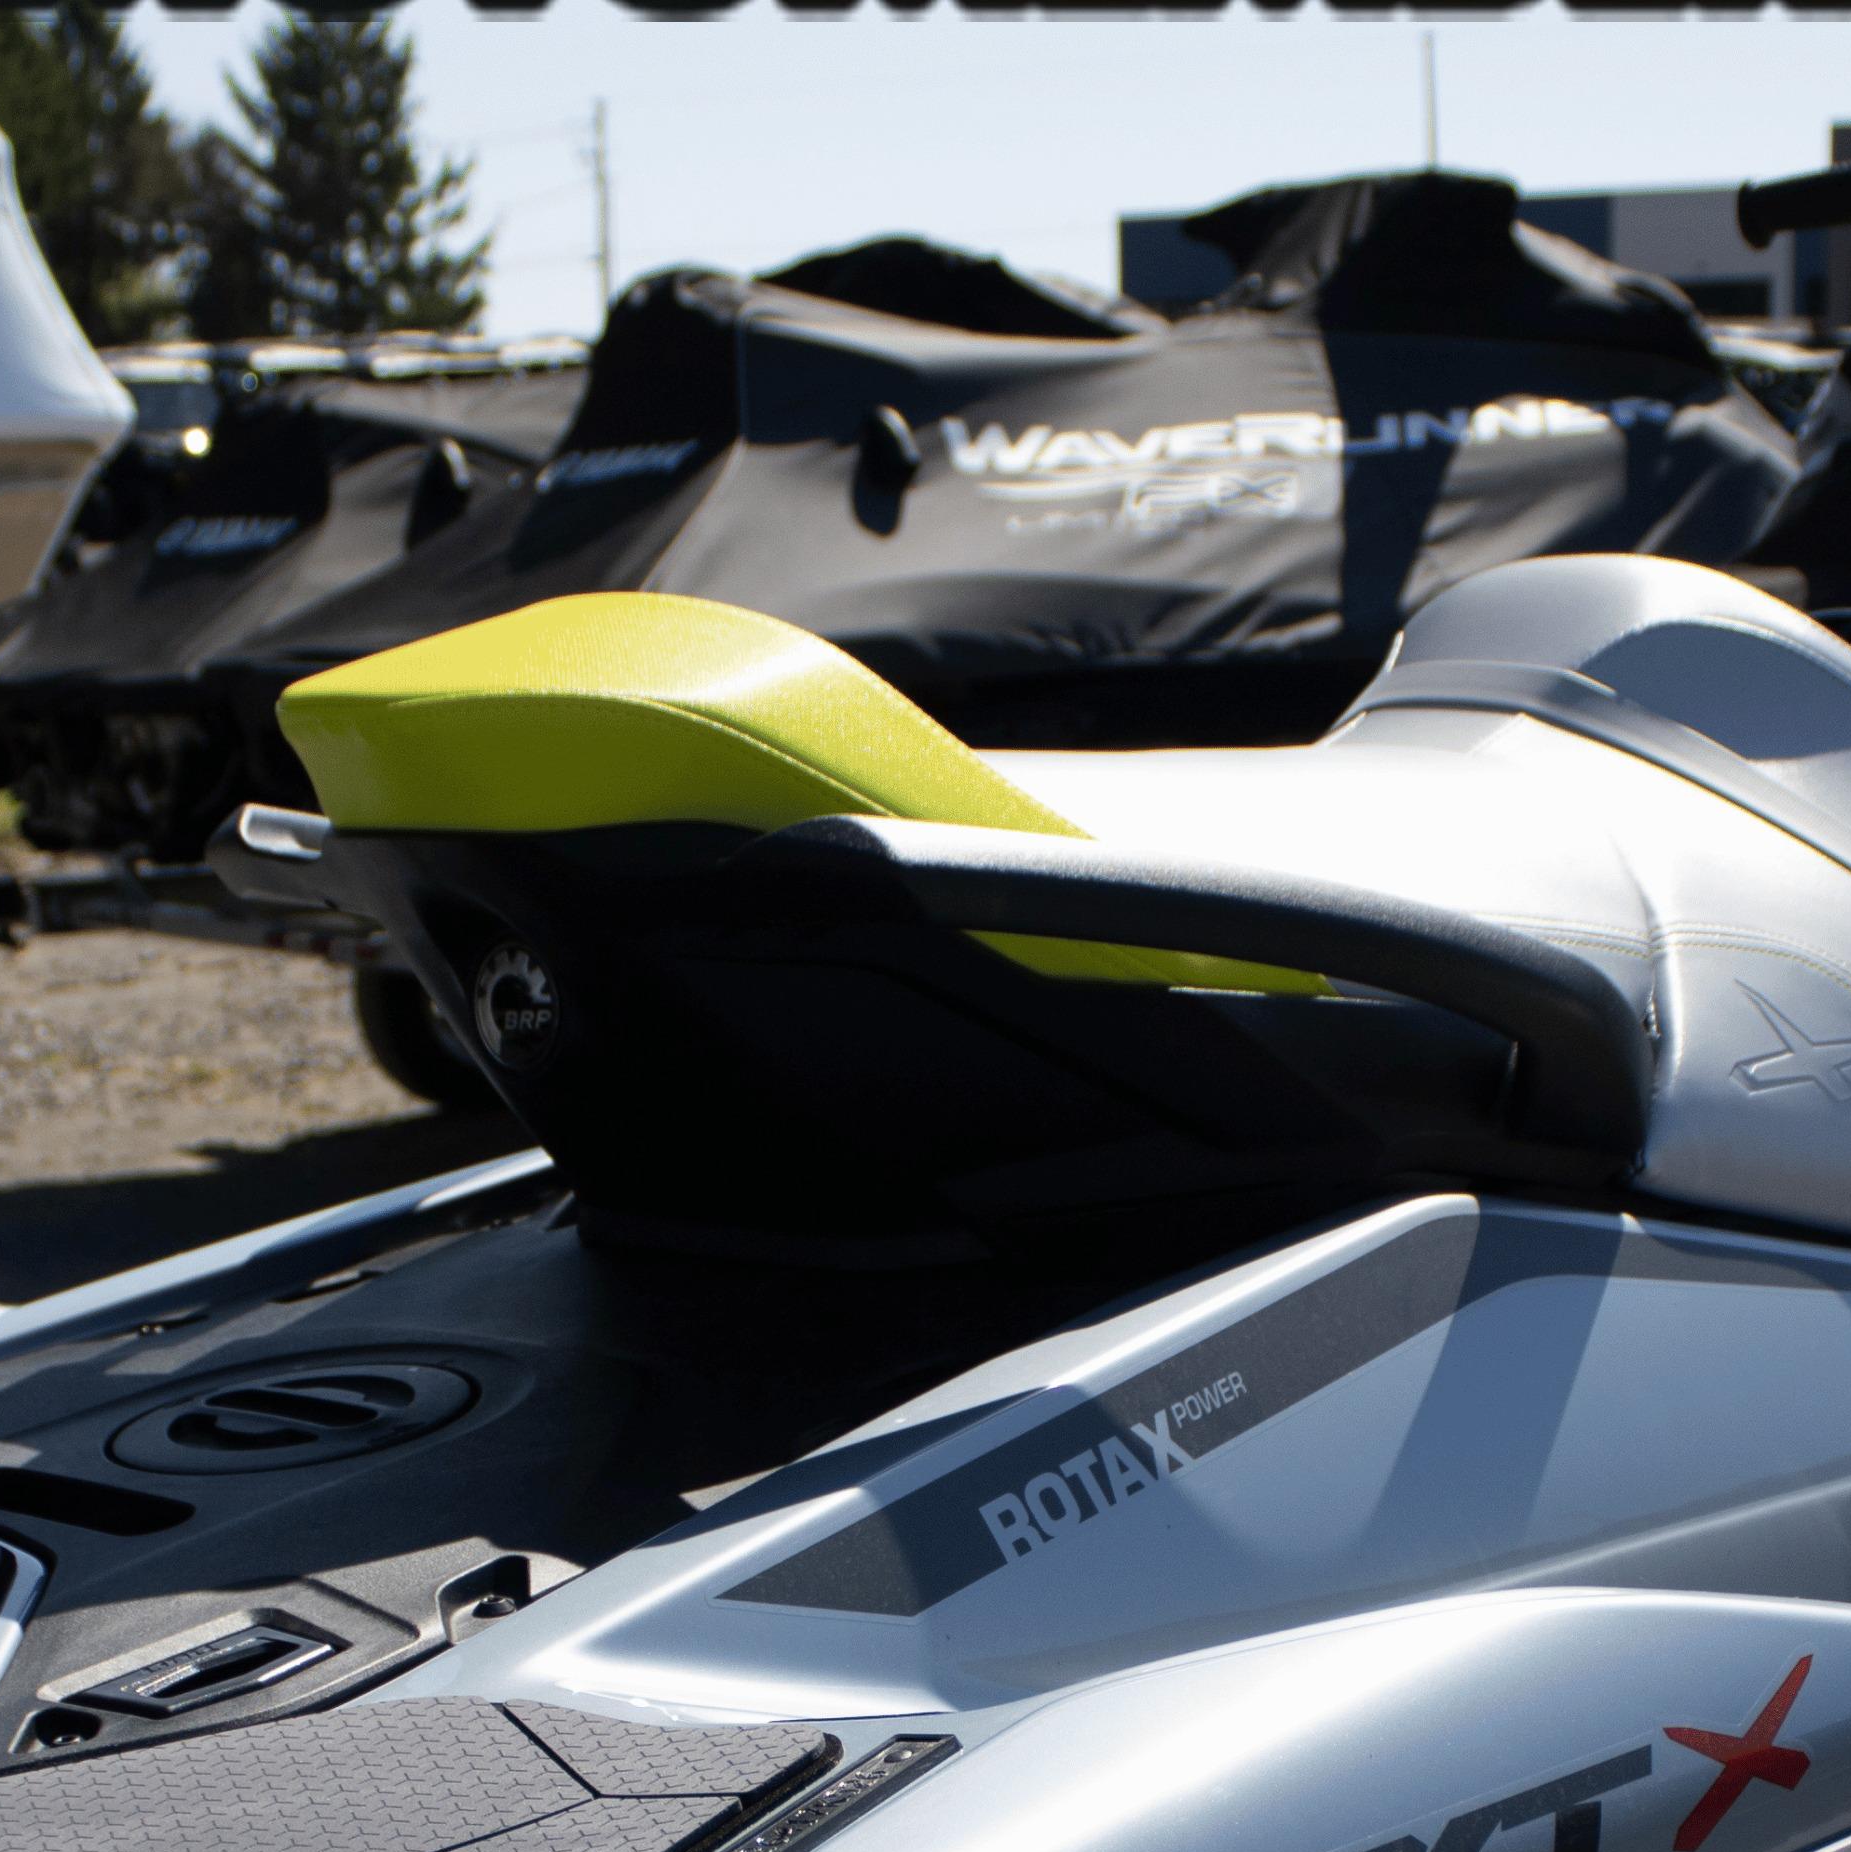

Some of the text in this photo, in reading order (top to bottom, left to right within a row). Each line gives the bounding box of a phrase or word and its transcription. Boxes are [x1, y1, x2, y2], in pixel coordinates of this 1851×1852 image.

[504, 1009, 553, 1031] BRP
[978, 1370, 1248, 1565] ROTAX POWER
